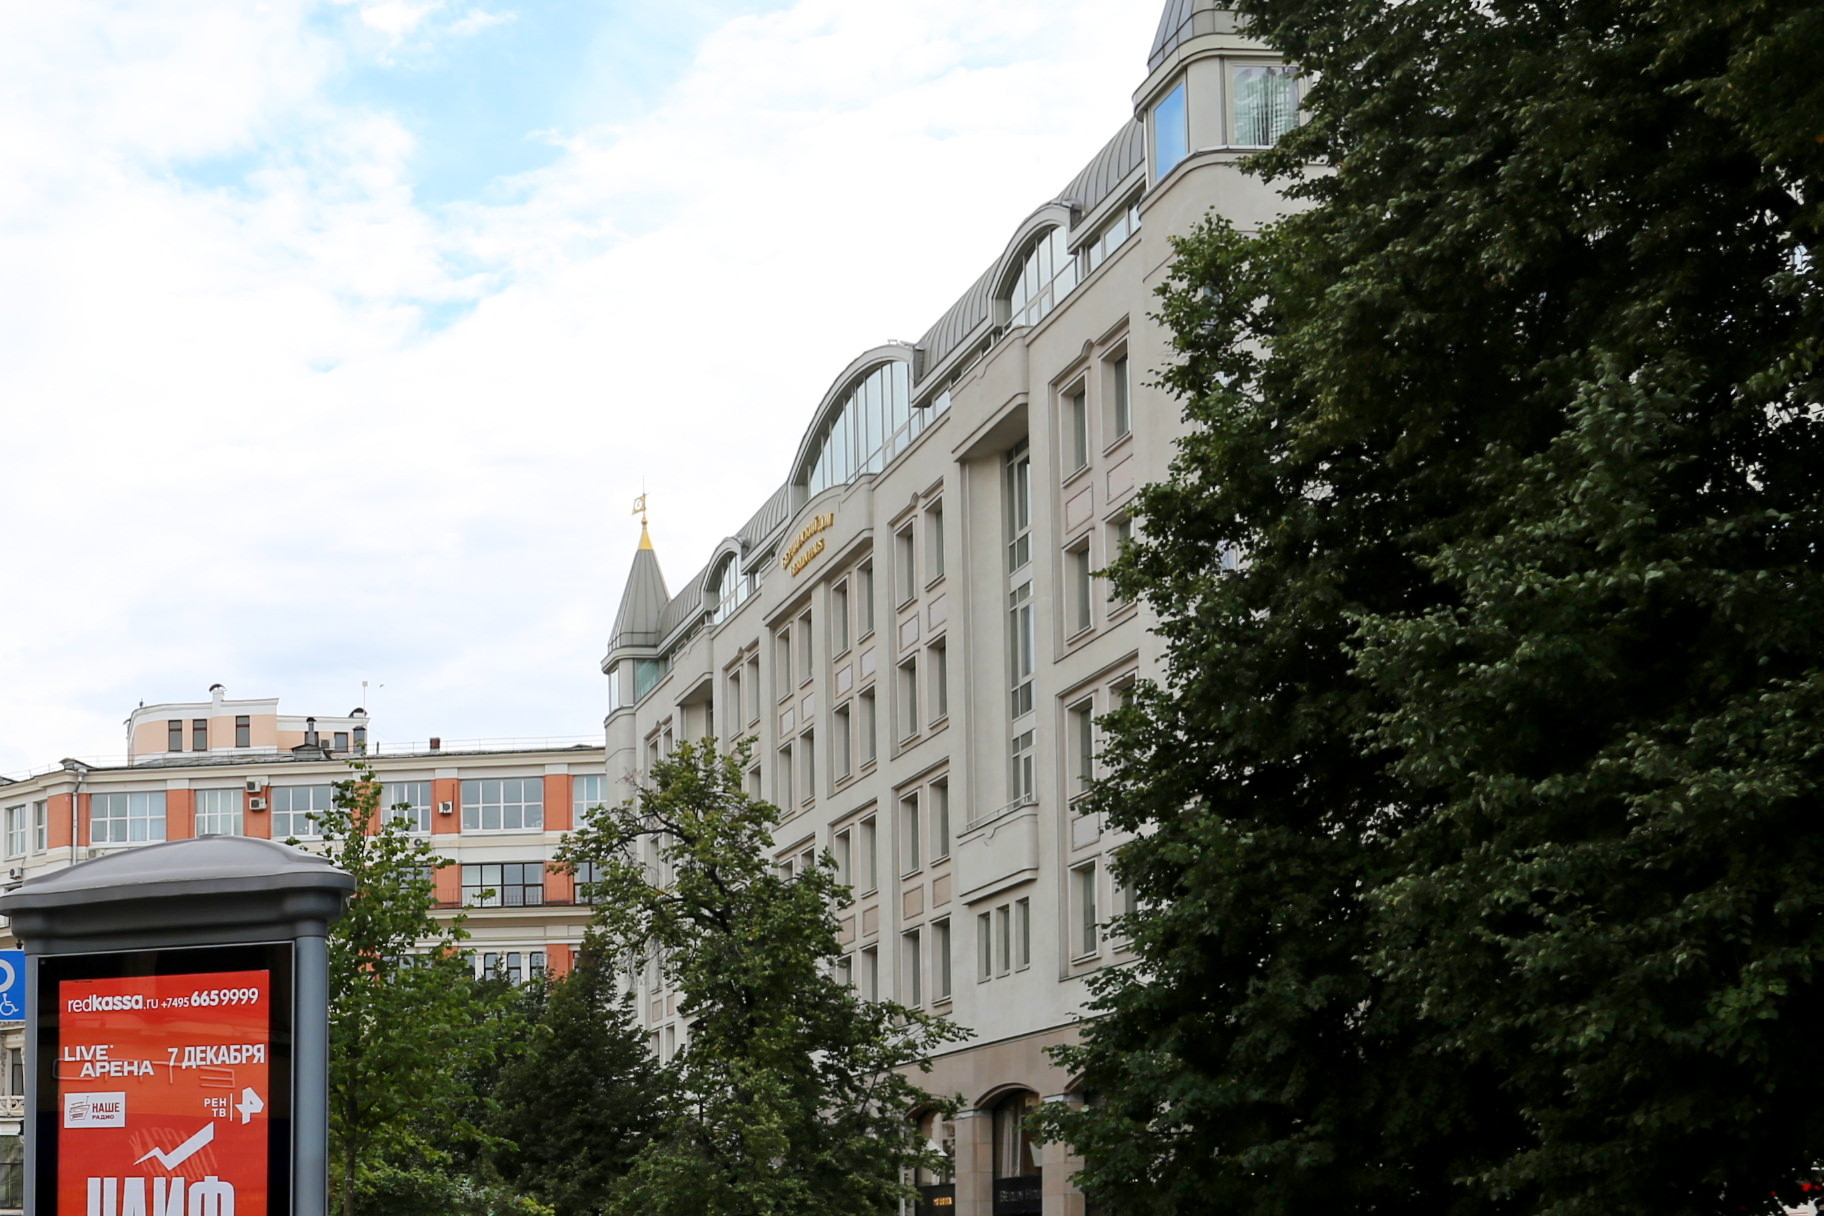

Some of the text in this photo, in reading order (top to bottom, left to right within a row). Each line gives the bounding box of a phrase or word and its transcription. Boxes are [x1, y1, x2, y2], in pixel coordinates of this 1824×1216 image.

[67, 994, 158, 1012] redkassa.ru
[64, 1045, 108, 1061] LIVE
[167, 1044, 265, 1069] 7 ДЕКАБРЯ
[80, 1060, 155, 1078] АРЕНА
[92, 1102, 120, 1113] НАШЕ
[204, 1098, 227, 1107] РЕН
[212, 1108, 227, 1118] ТВ
